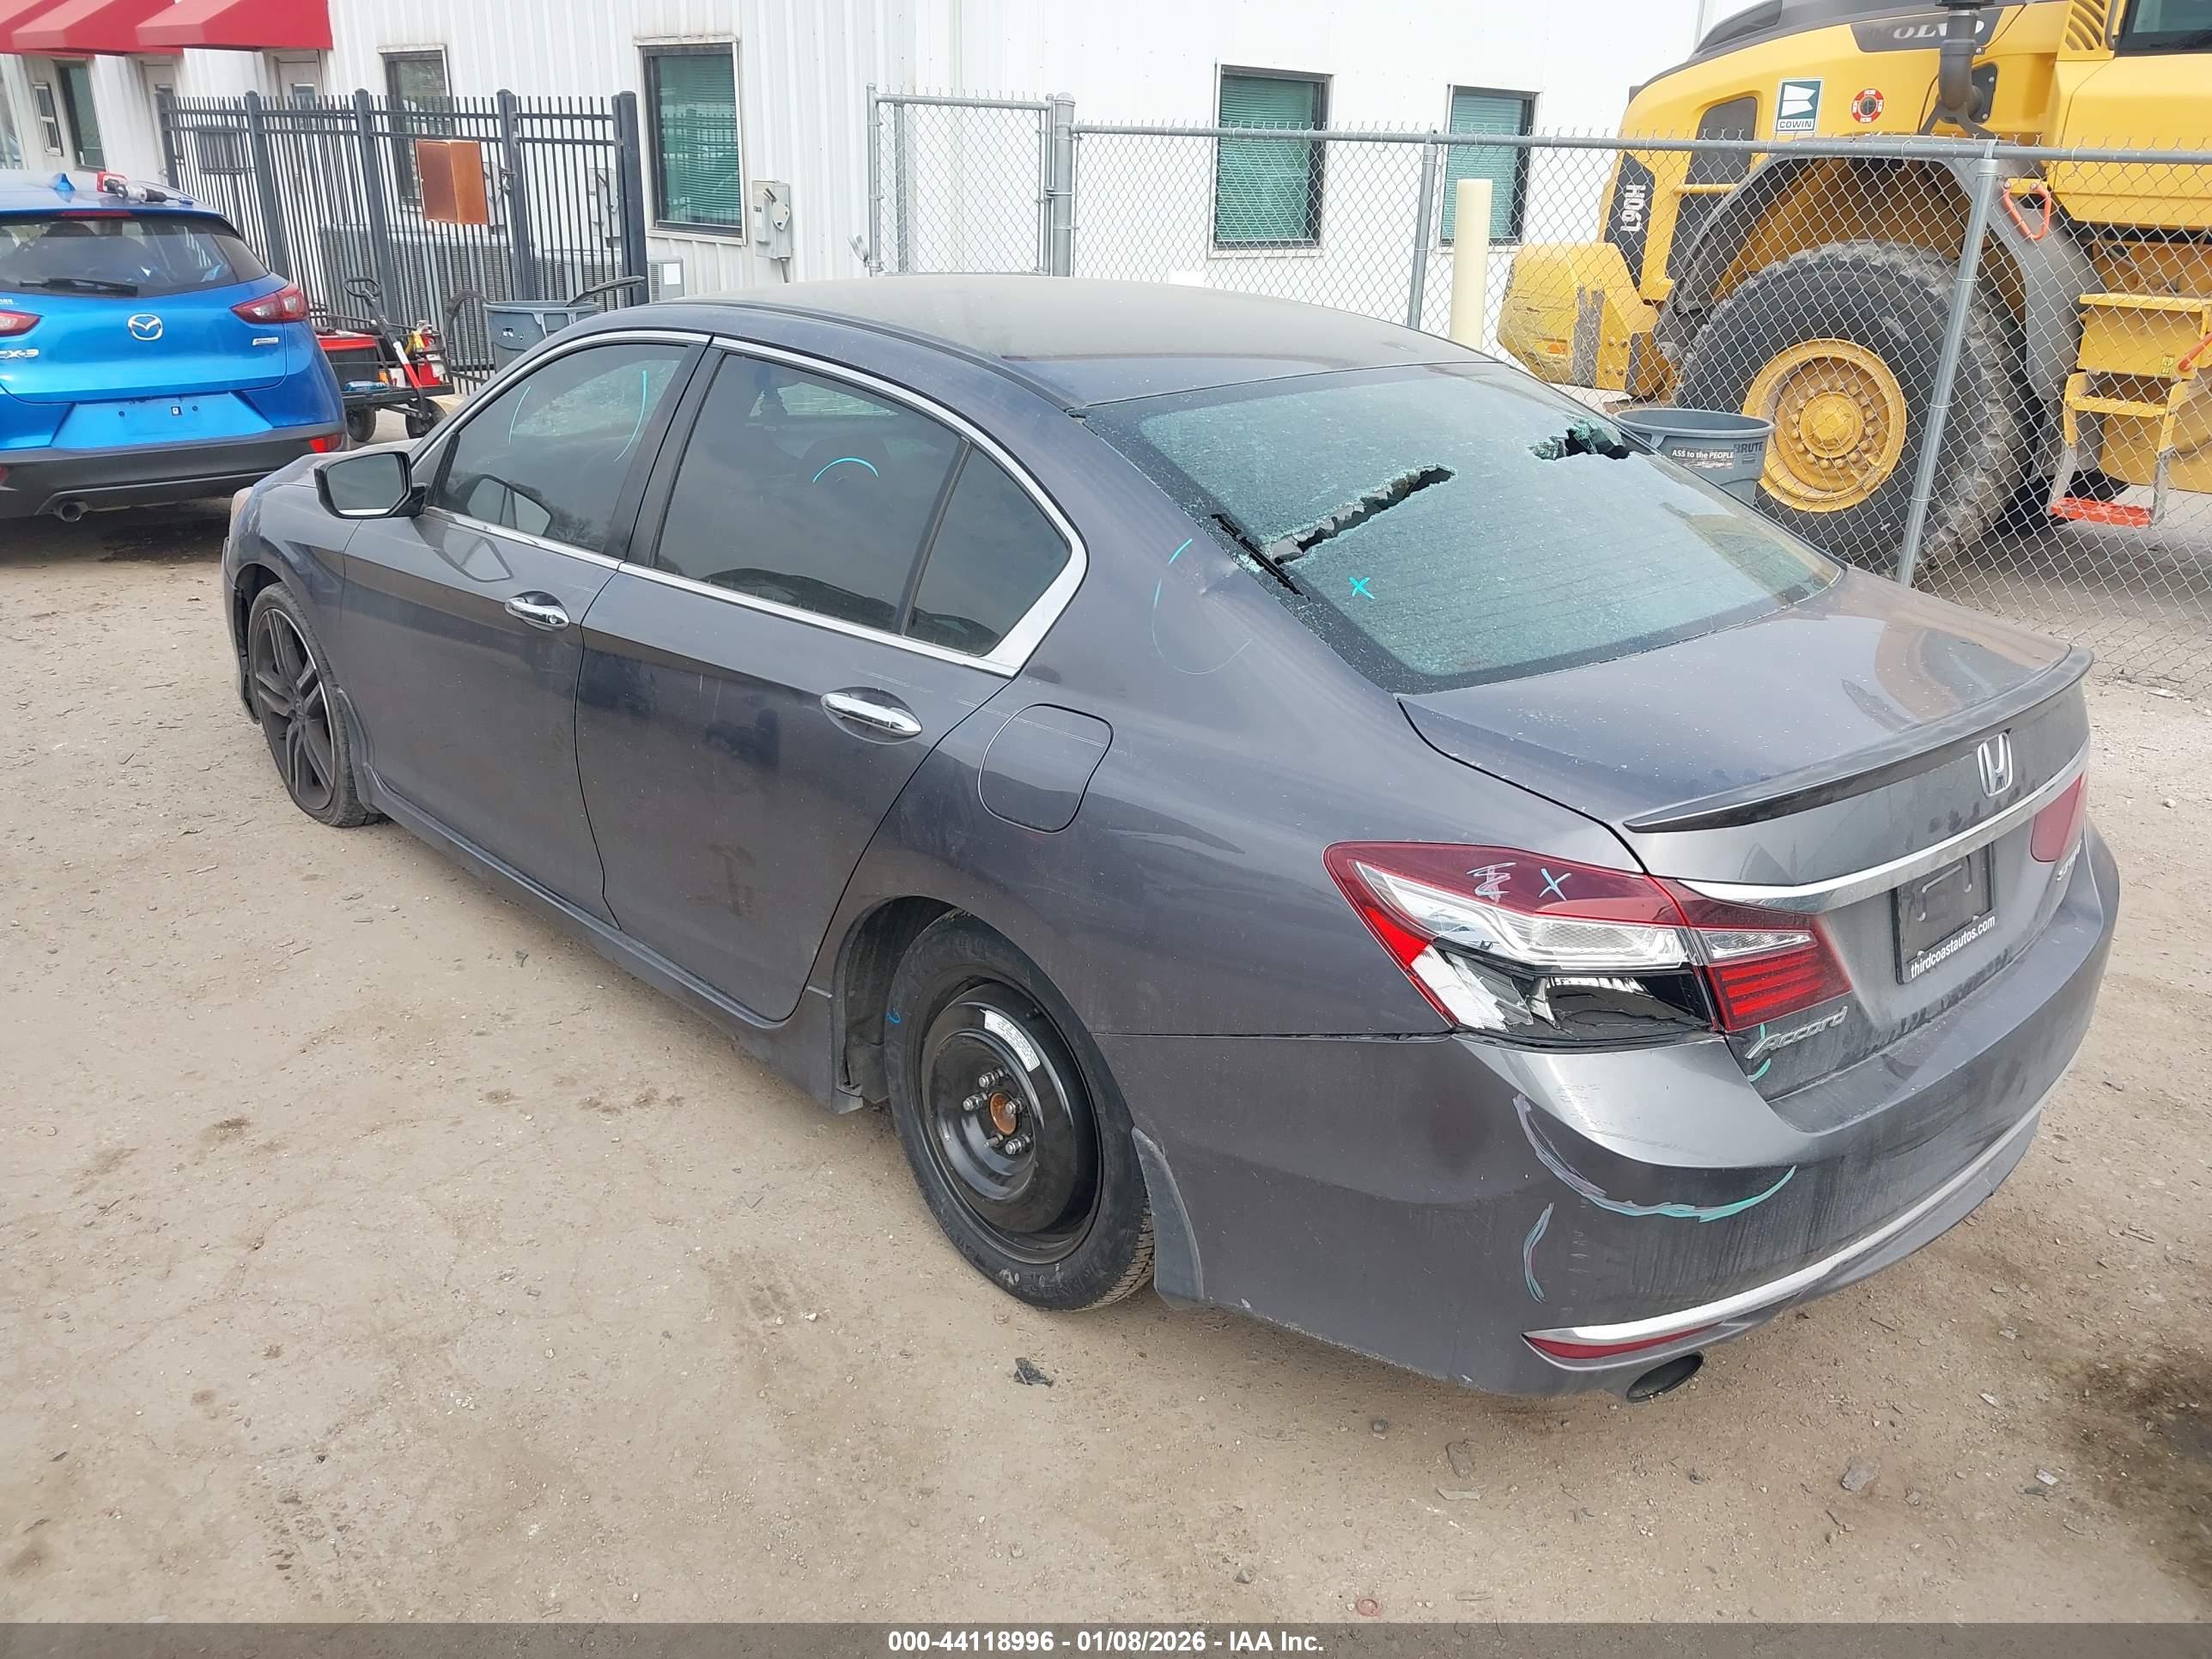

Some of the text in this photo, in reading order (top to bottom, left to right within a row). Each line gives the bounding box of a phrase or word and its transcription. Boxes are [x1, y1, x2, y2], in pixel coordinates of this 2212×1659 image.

[1779, 120, 1813, 129] COWIN
[1620, 185, 1647, 232] L90H
[1734, 441, 1764, 453] BRUTE
[1687, 450, 1695, 459] to
[1696, 451, 1708, 459] the
[1911, 915, 1996, 979] thirdcoastautos.com
